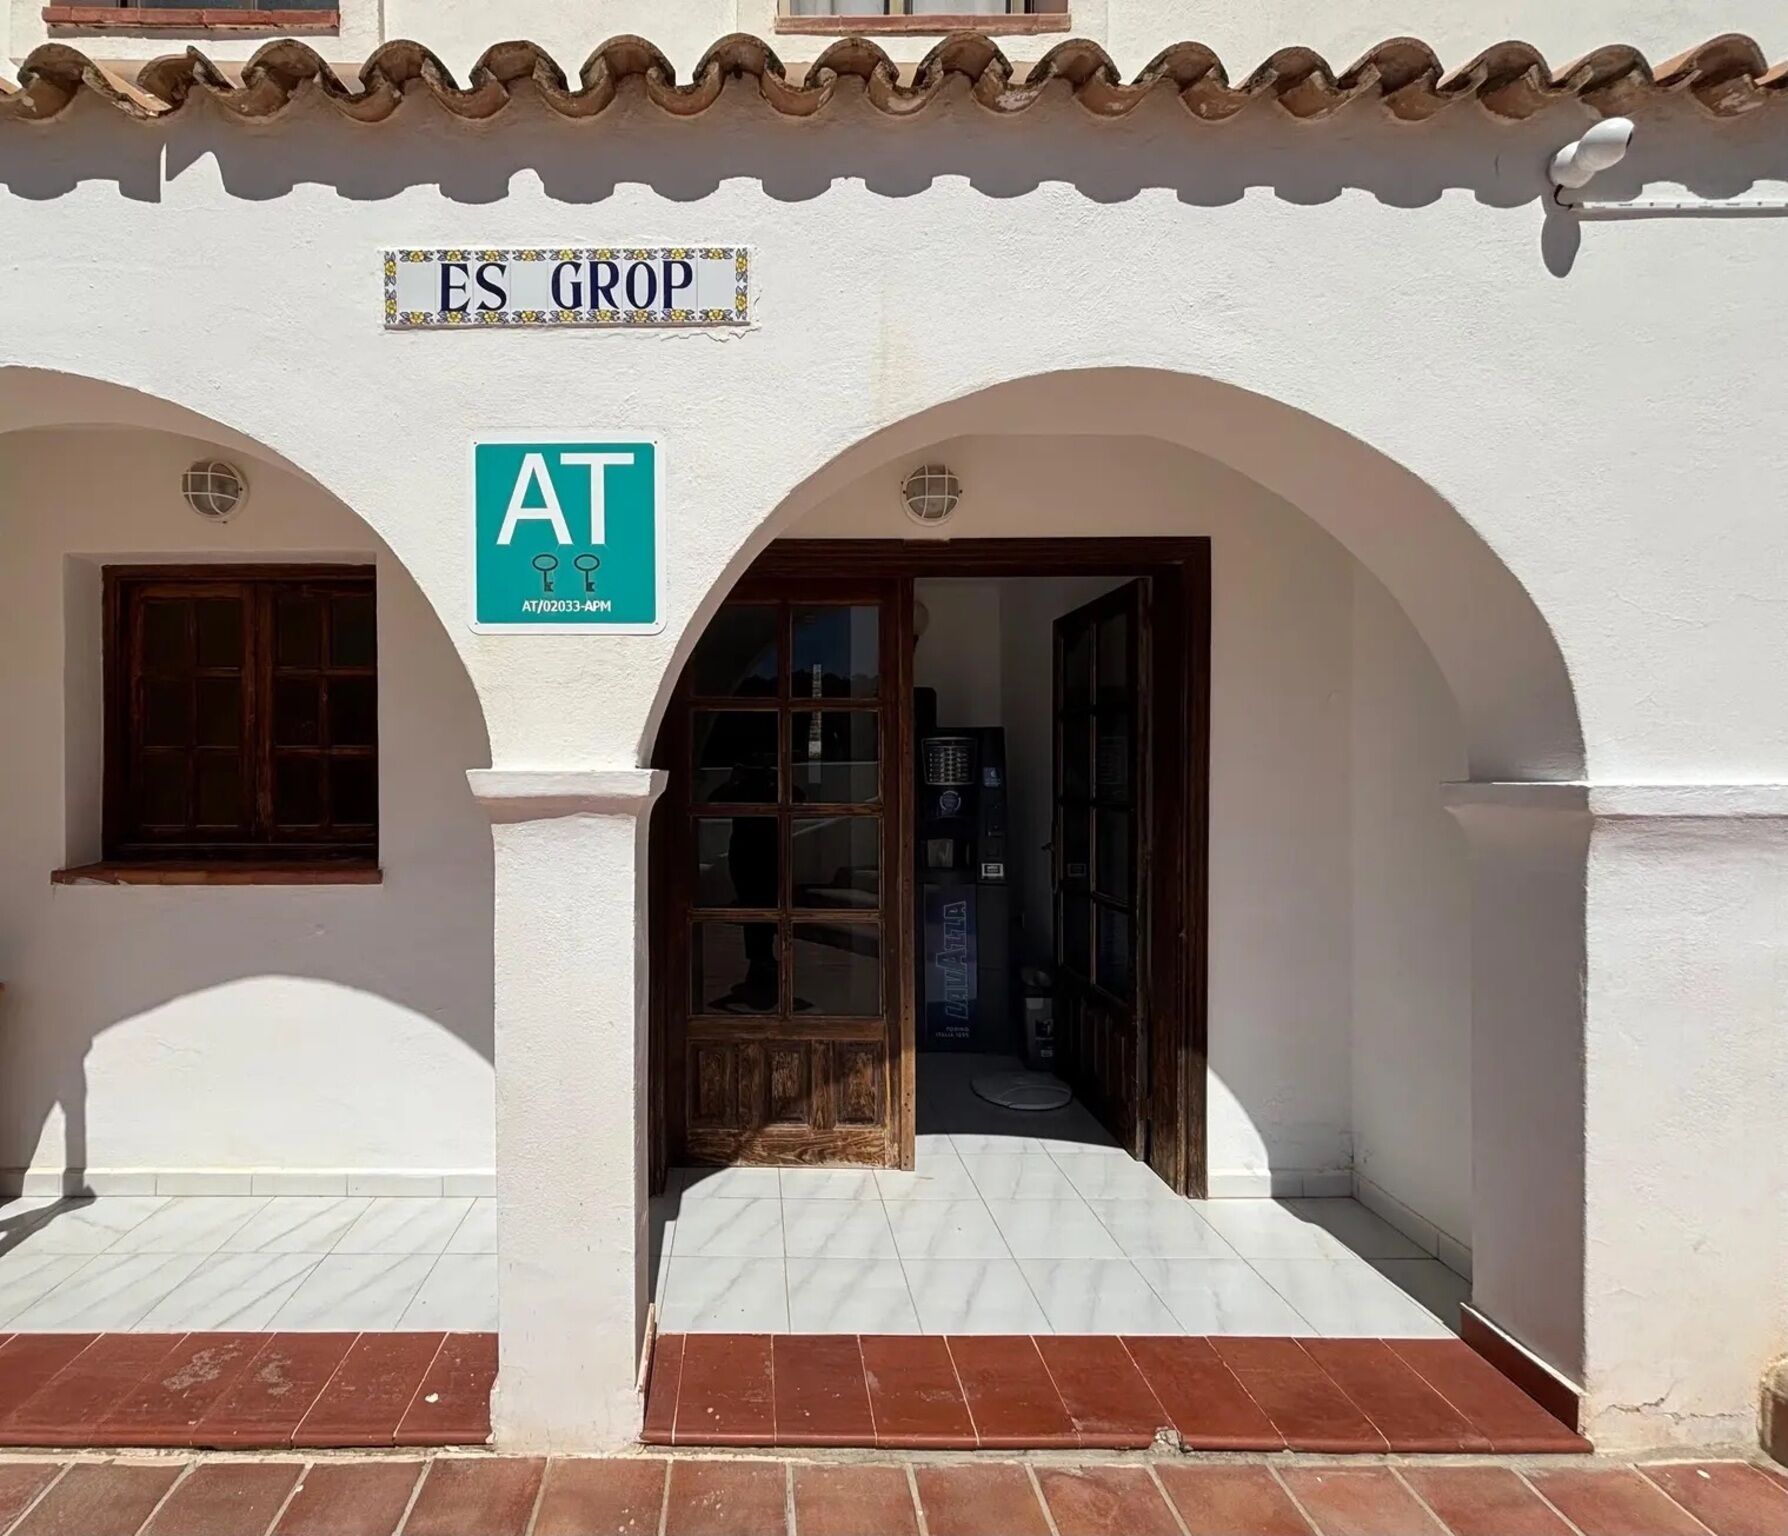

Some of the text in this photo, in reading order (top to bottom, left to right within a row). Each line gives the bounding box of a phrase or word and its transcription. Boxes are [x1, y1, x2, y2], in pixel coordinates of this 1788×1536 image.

[440, 260, 693, 312] ES GROP
[496, 452, 635, 545] AT
[521, 599, 612, 614] AT/02033-APM
